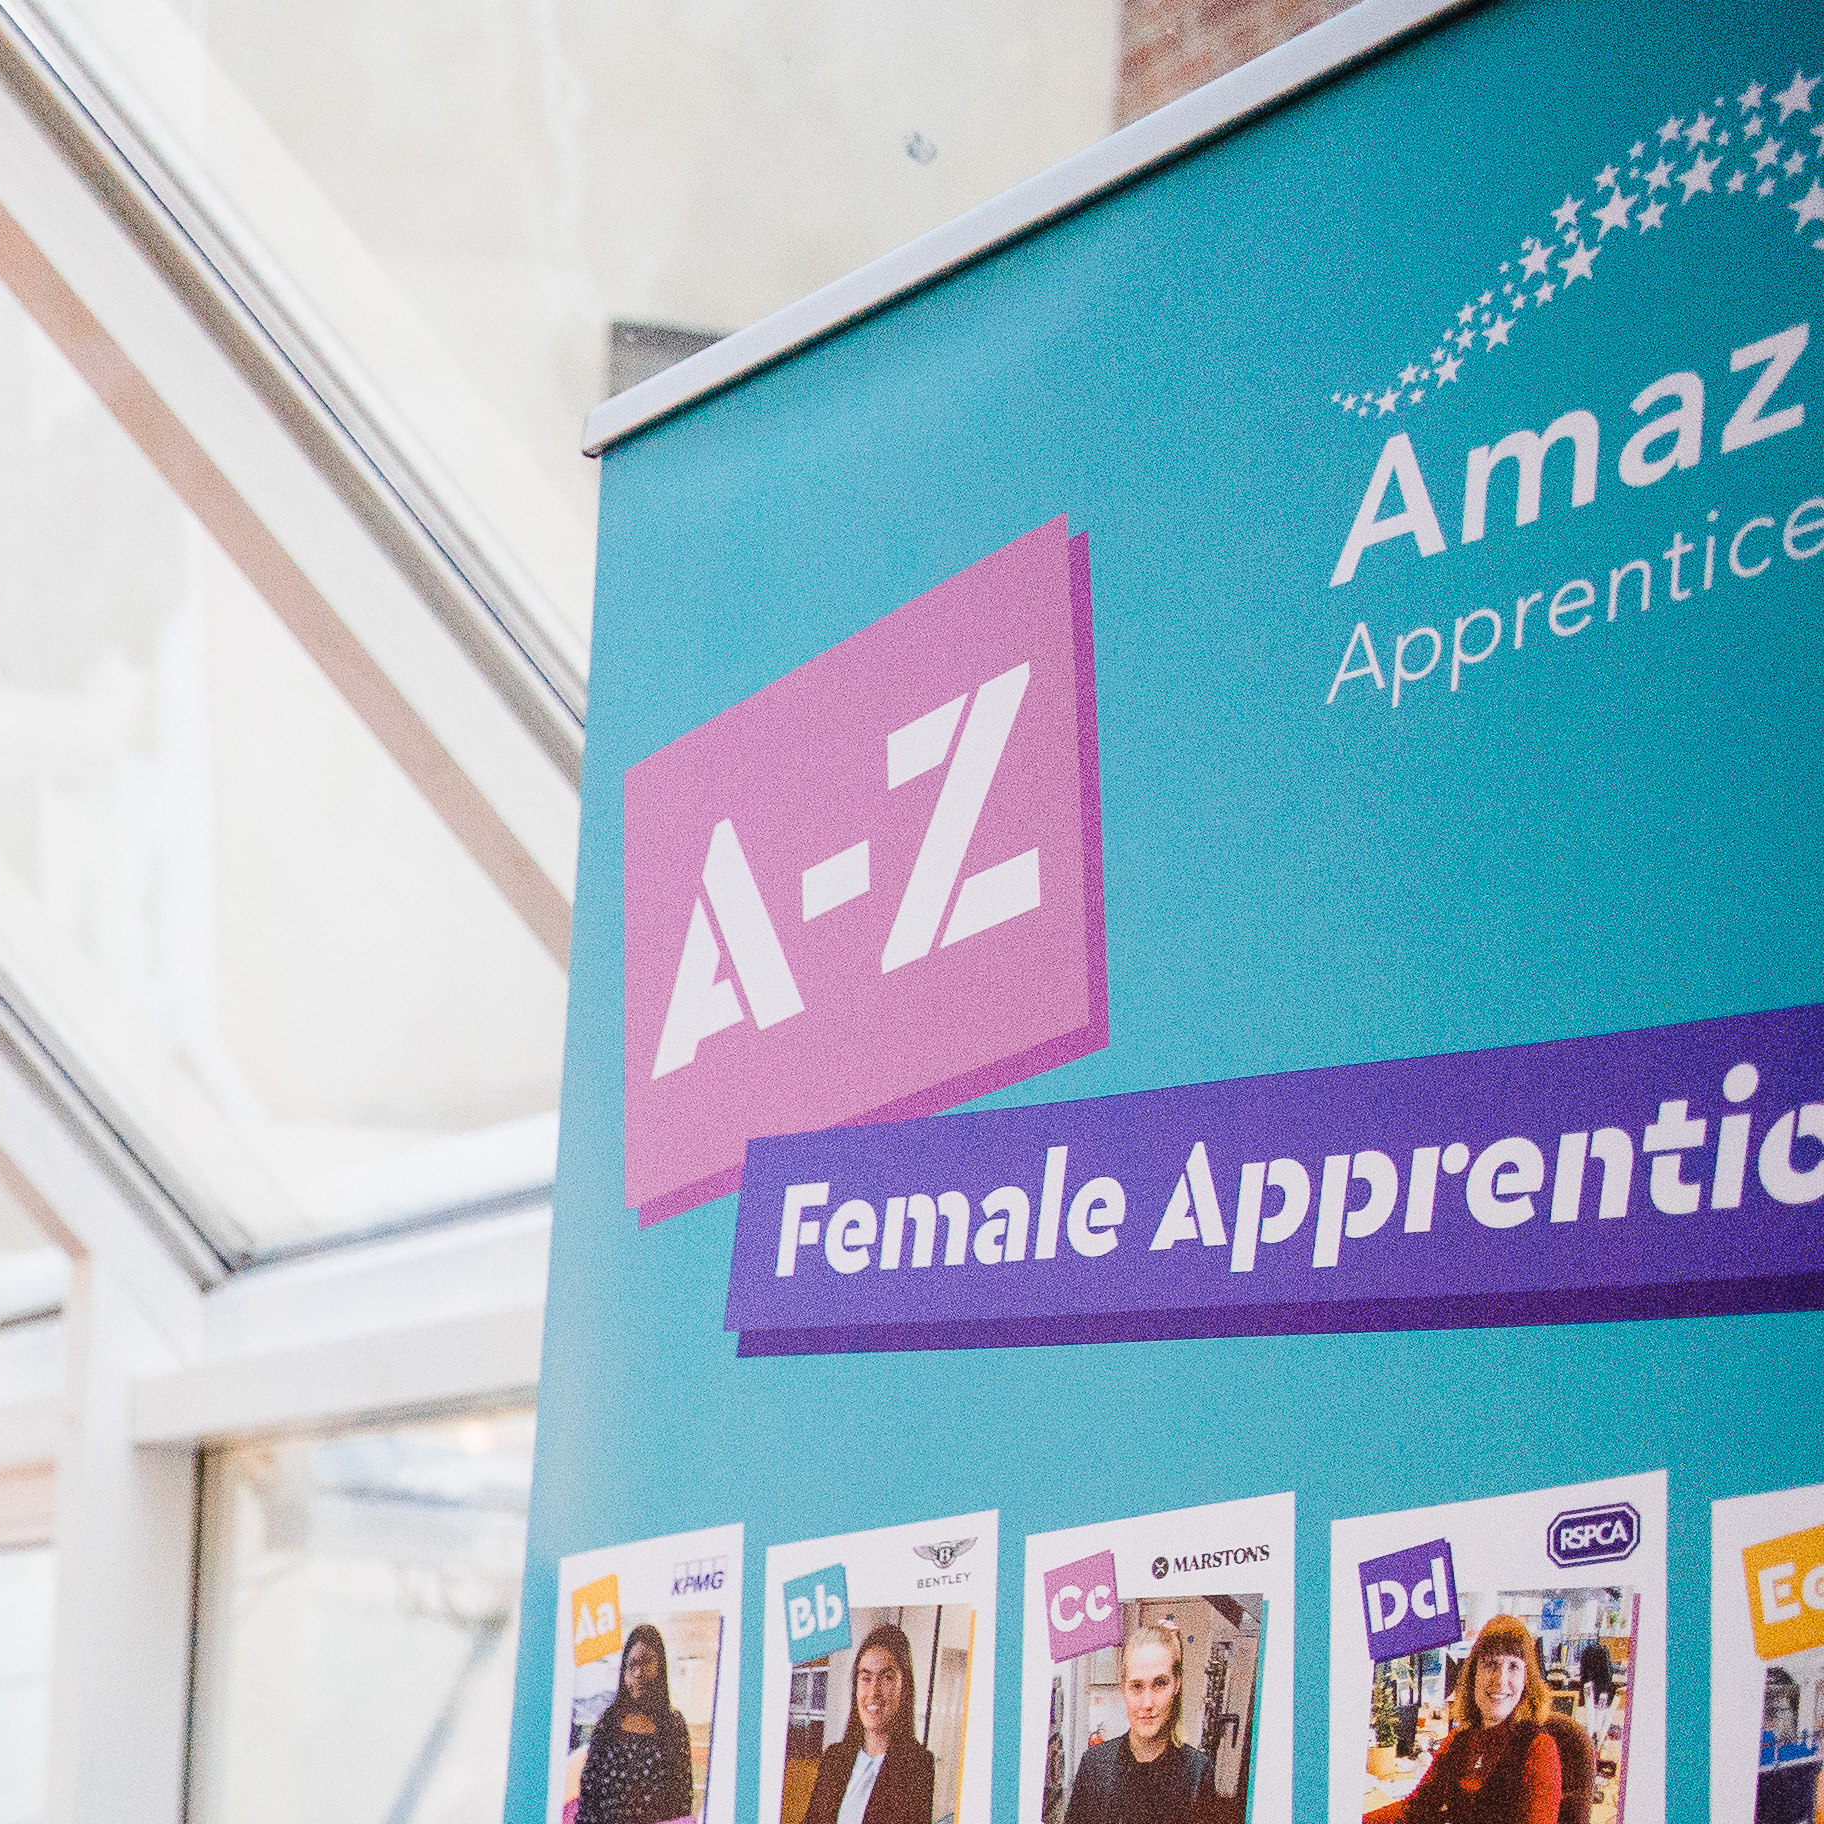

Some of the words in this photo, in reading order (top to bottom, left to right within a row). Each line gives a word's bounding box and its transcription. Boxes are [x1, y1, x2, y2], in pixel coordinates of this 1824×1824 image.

[1328, 320, 1811, 589] Amaz
[651, 660, 1042, 1080] A-Z
[775, 1143, 1128, 1279] Female
[1558, 1516, 1629, 1552] RSPCA
[671, 1569, 726, 1597] KPMG
[916, 1572, 973, 1590] BENTLEY
[1049, 1583, 1115, 1633] Cc
[1365, 1556, 1450, 1634] Dd
[574, 1604, 615, 1644] Aa
[788, 1582, 845, 1641] Bb
